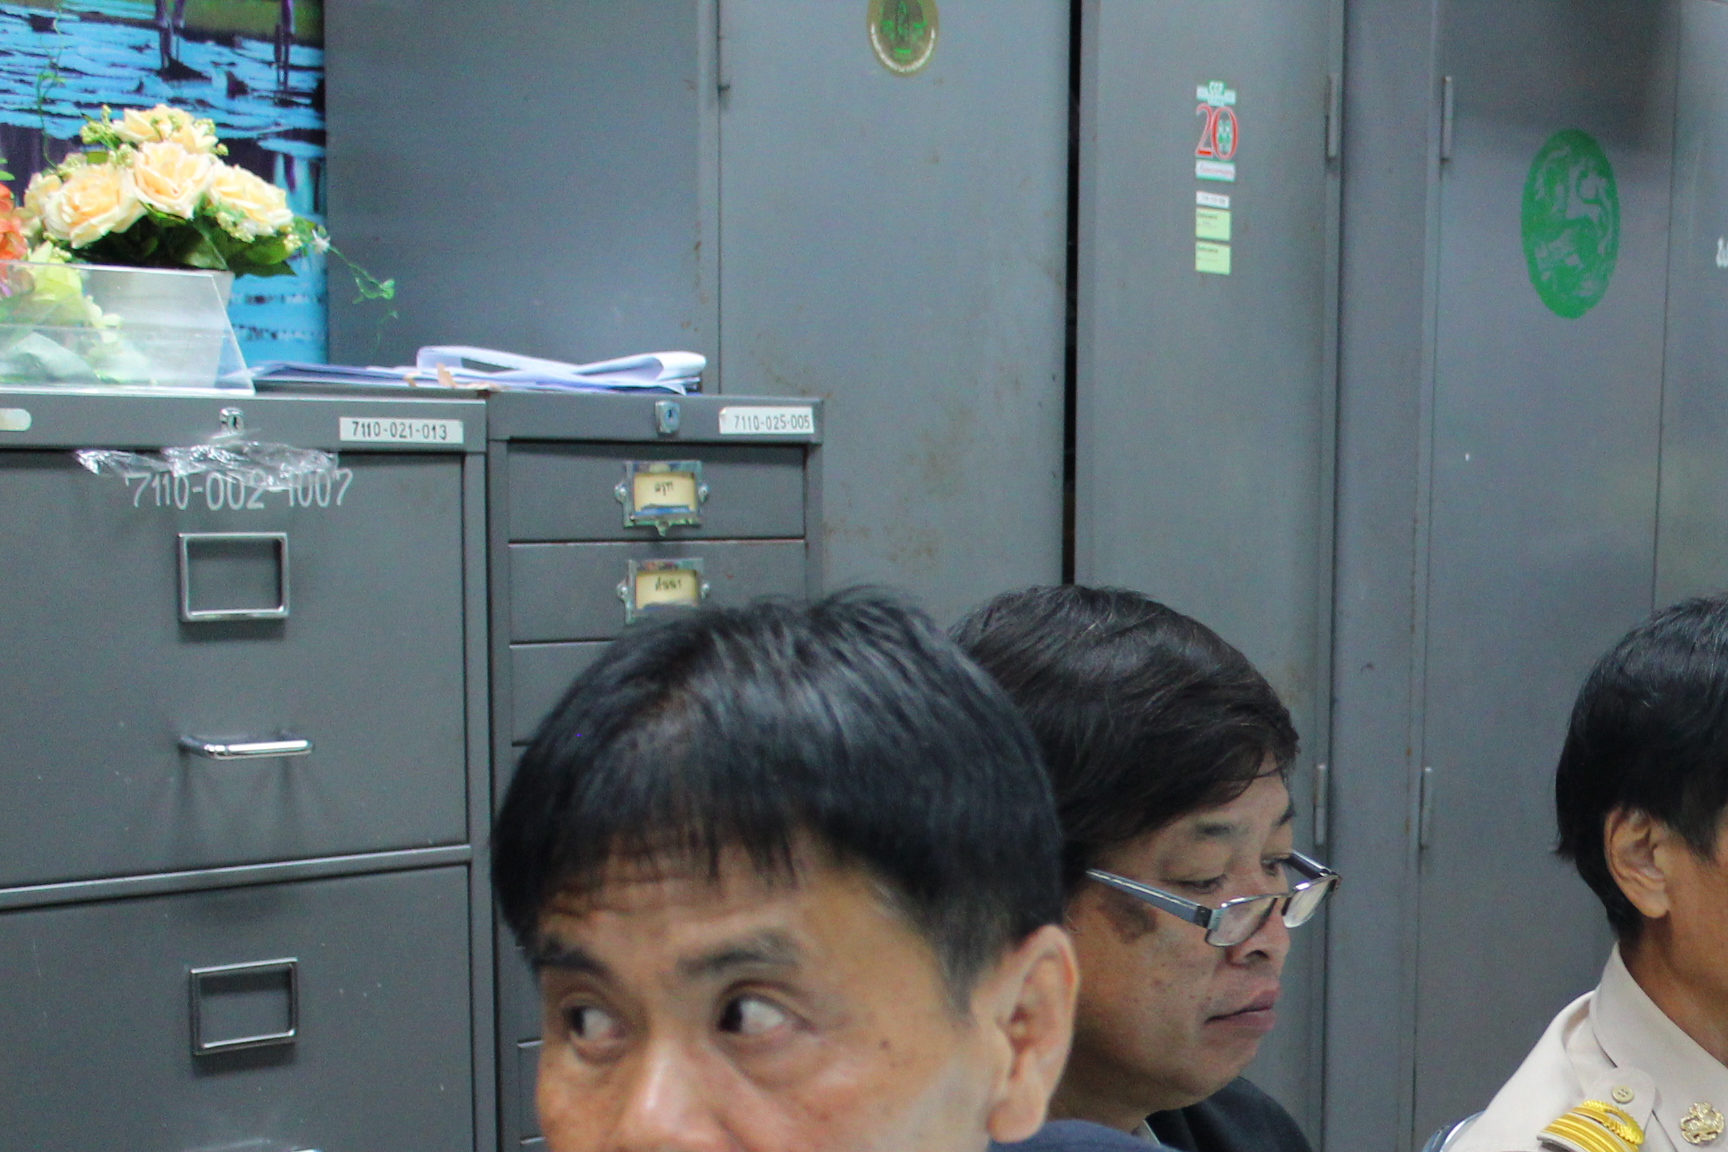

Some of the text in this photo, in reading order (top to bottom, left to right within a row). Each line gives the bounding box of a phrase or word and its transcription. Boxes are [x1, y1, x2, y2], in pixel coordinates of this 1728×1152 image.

[1195, 103, 1239, 161] 20
[351, 420, 448, 441] 7110-021-013
[734, 414, 811, 431] 7110-025-005
